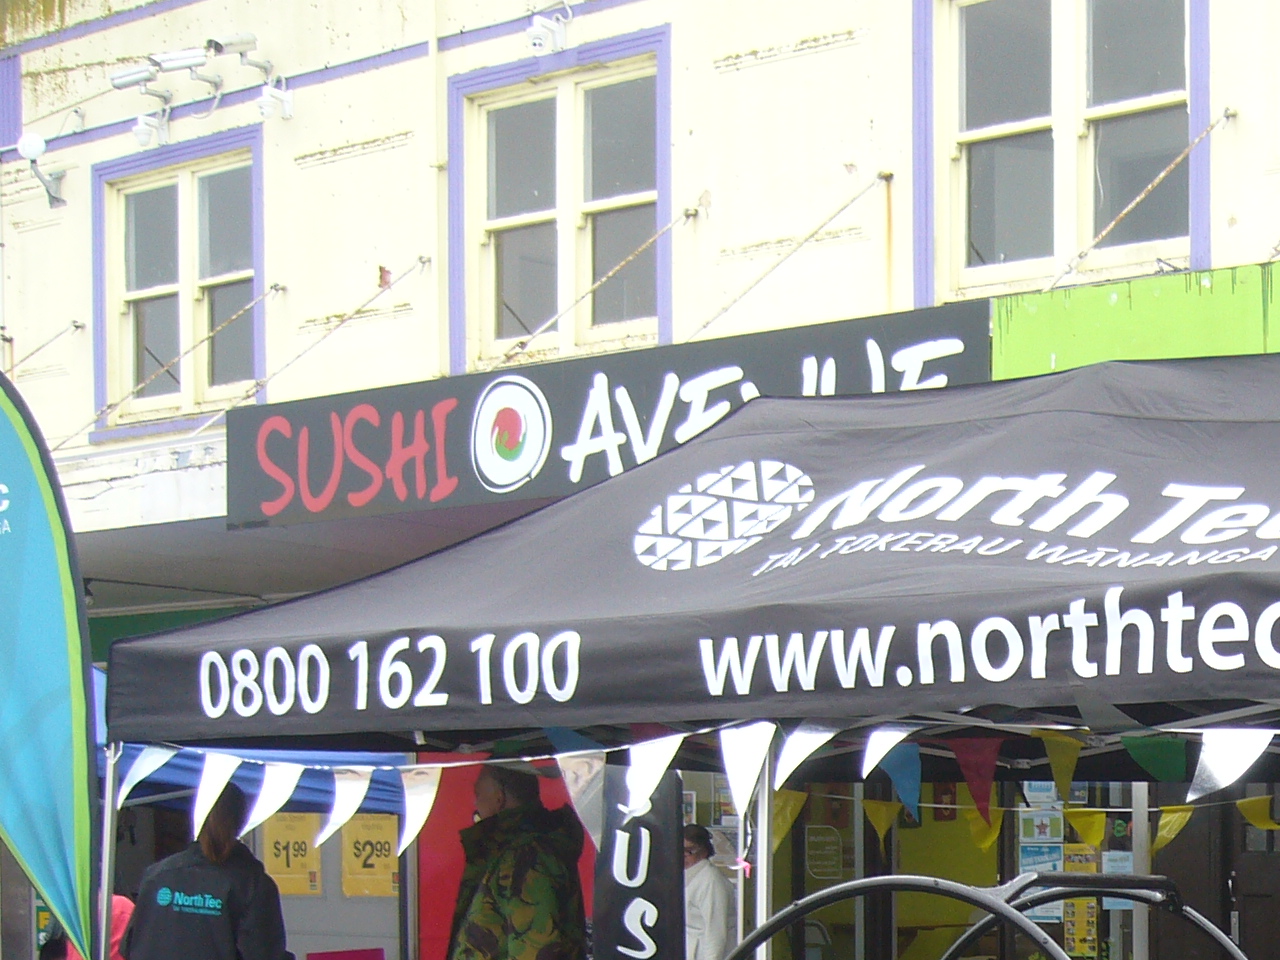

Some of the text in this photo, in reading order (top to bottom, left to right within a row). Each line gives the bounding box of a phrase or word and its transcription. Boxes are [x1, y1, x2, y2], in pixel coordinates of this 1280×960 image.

[256, 398, 458, 517] SUSHI
[791, 464, 1130, 540] North
[752, 543, 820, 577] TAI
[819, 532, 1022, 559] TOKERAU
[200, 630, 581, 719] 0800 162 100
